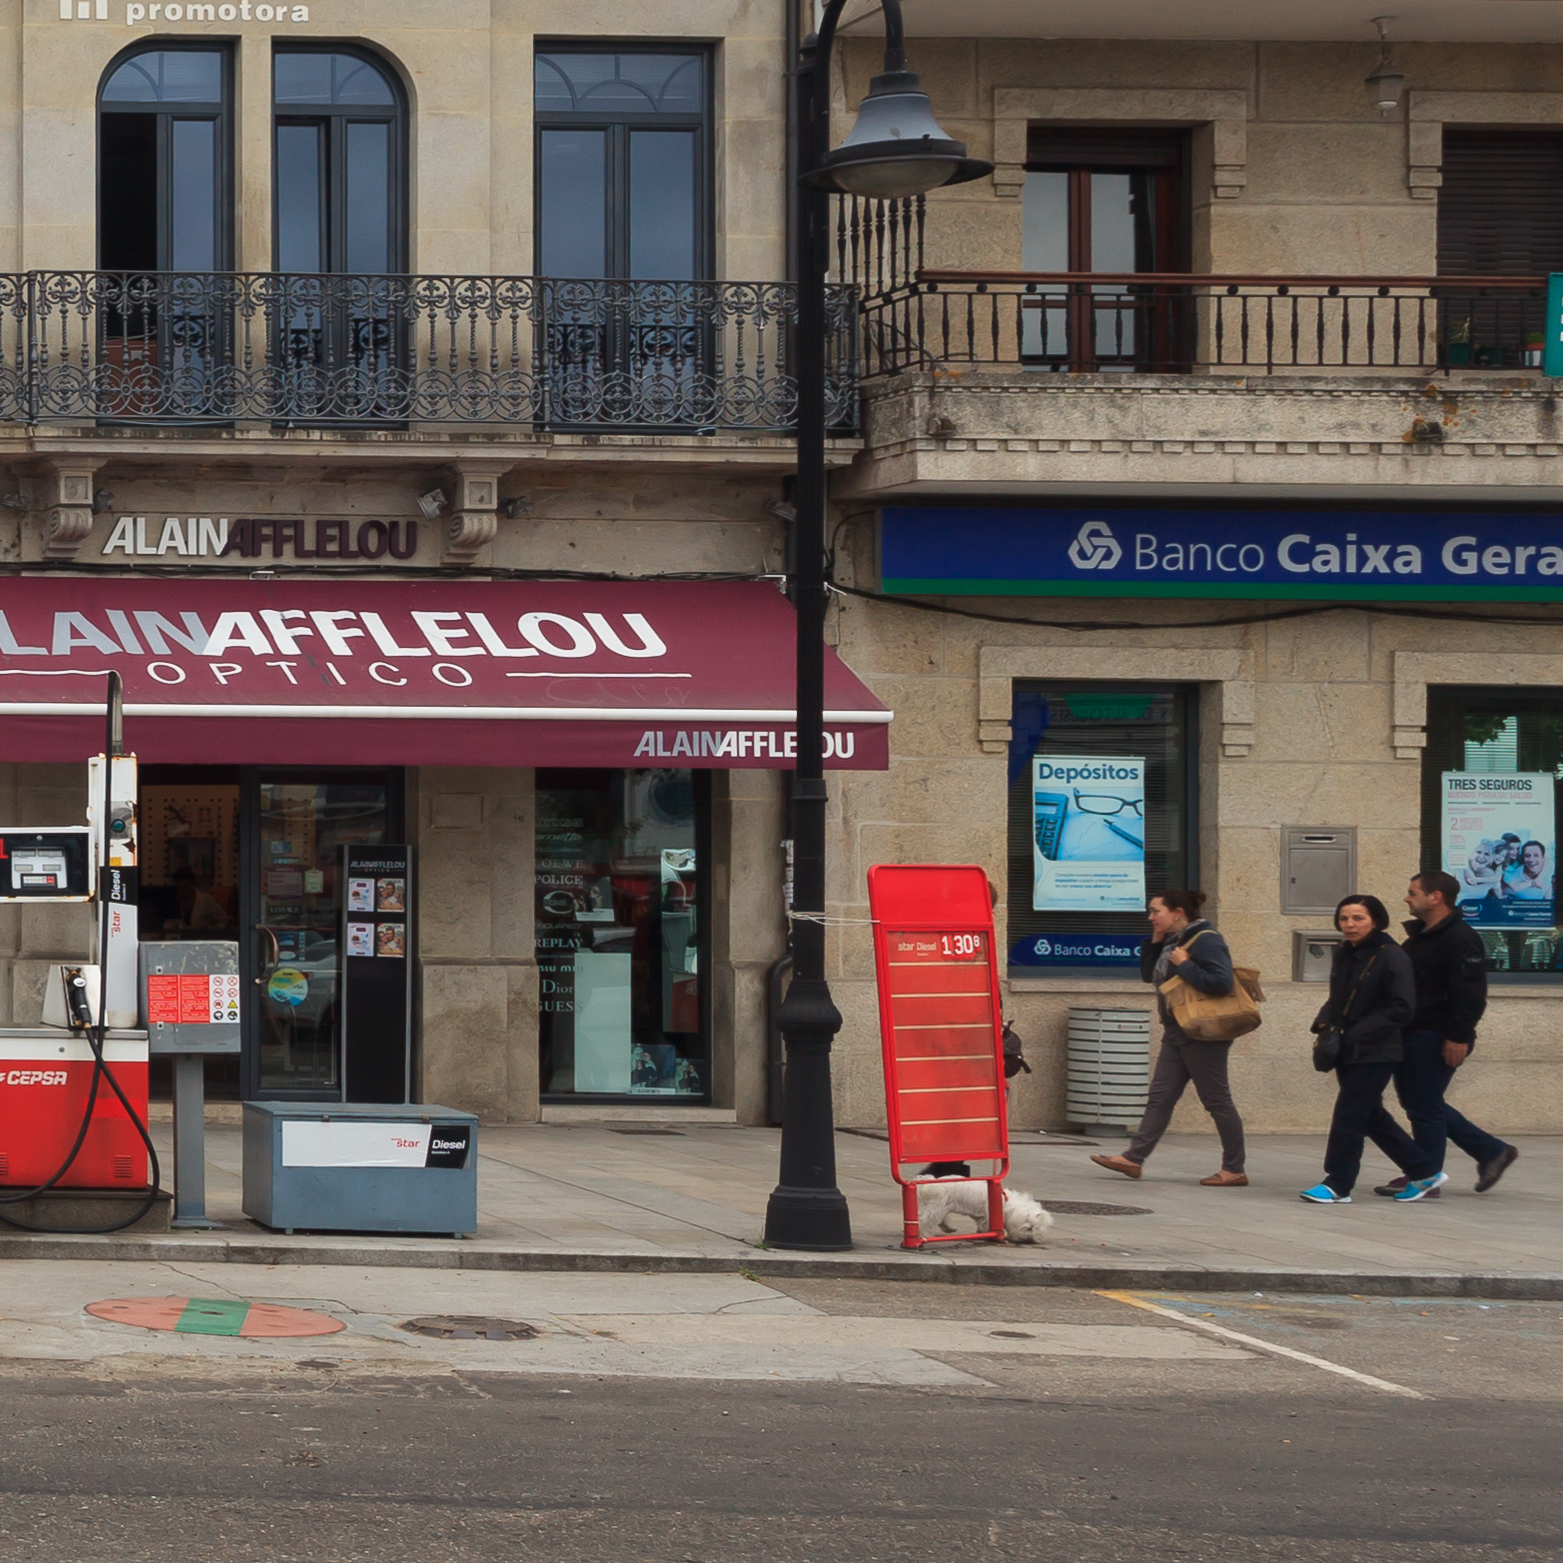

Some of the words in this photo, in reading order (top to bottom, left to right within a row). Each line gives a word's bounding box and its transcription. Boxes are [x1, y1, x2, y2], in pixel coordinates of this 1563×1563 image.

[126, 0, 309, 25] promotora
[1135, 534, 1264, 572] Banco
[1277, 534, 1422, 574] Caixa
[147, 661, 473, 686] OPTICO
[1039, 763, 1138, 783] Depósitos
[1448, 779, 1476, 790] TRES
[1479, 780, 1532, 790] SEGUROS
[1450, 818, 1458, 830] 2
[111, 869, 120, 900] Diesel
[535, 875, 583, 885] POLICE
[112, 911, 121, 933] star
[535, 938, 583, 948] REPLAY
[898, 942, 915, 951] star
[917, 942, 936, 951] Diesel
[1054, 944, 1091, 956] Banco
[1094, 945, 1130, 956] Caixa
[542, 980, 573, 993] Dior
[7, 1070, 67, 1085] CEPSA
[432, 1140, 465, 1149] Diesel
